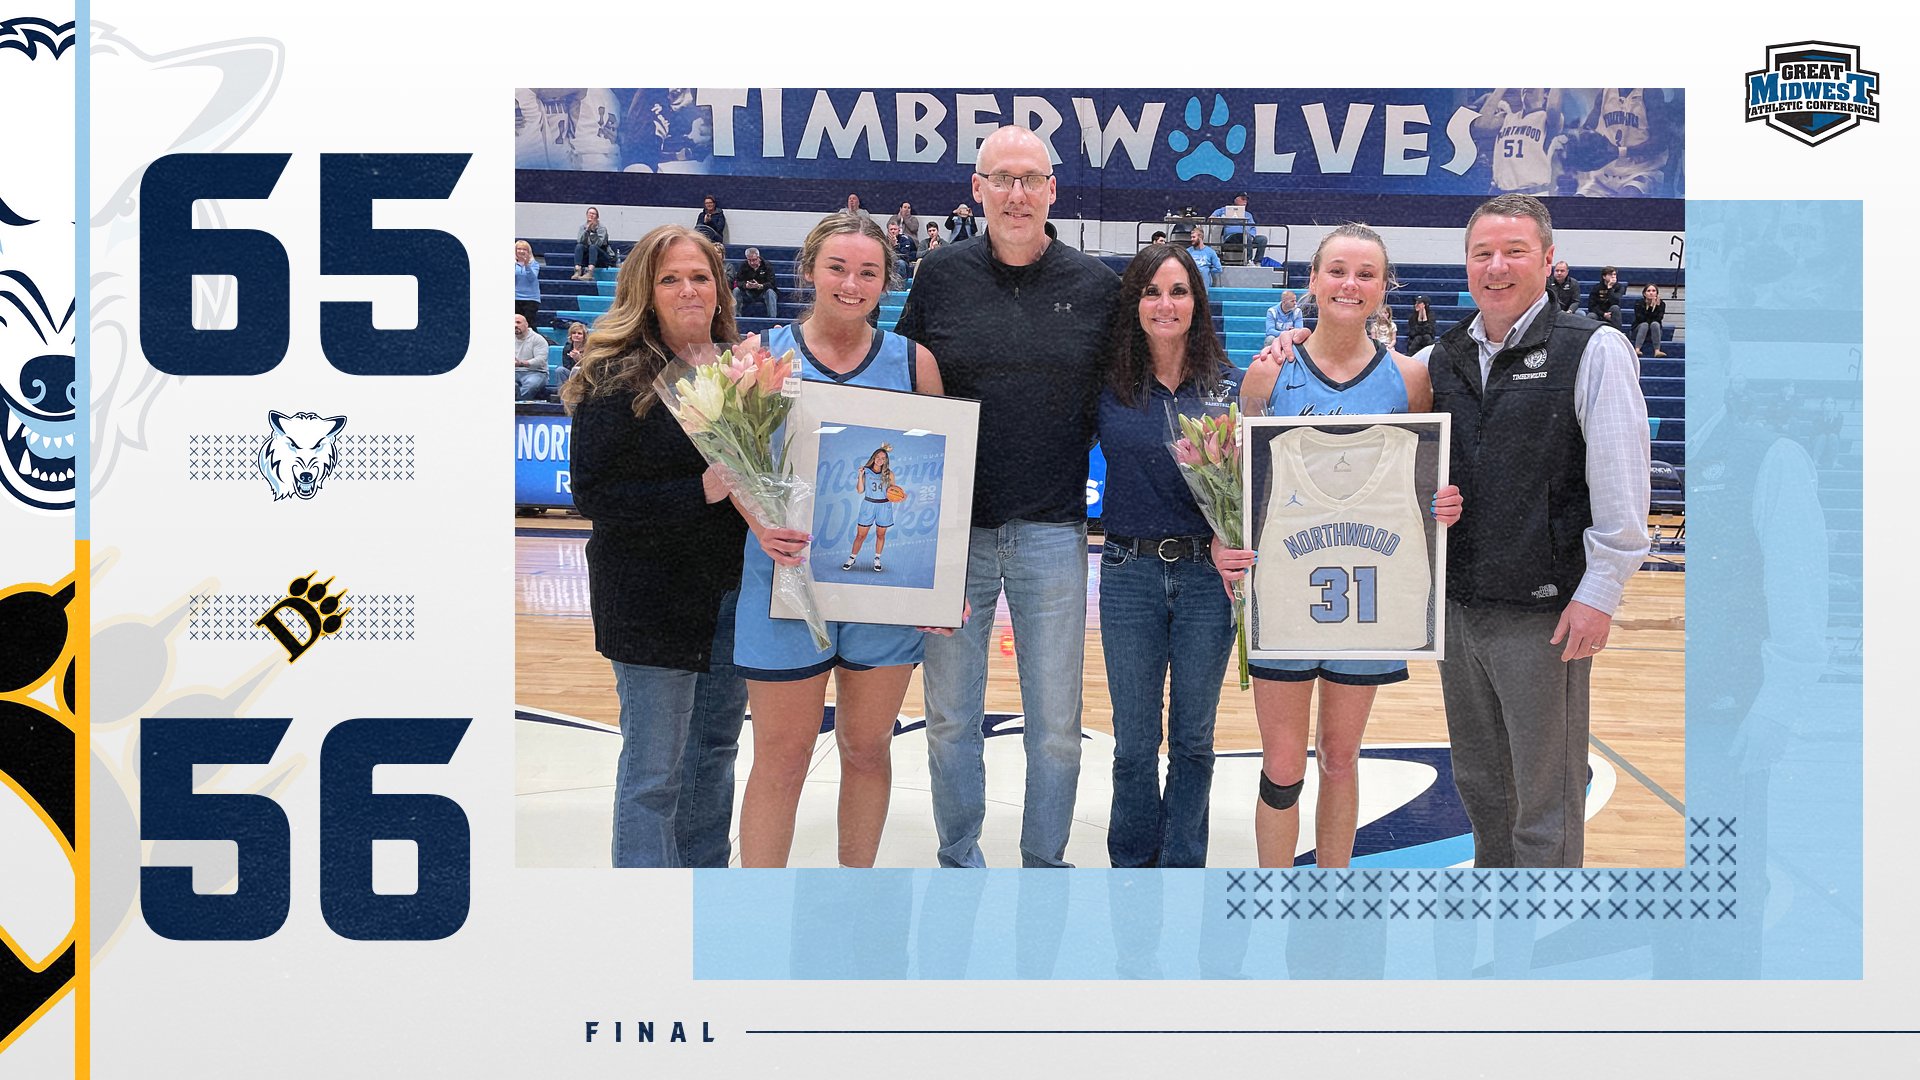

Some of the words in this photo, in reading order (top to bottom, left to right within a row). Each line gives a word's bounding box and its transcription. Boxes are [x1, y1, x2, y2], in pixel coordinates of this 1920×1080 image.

[1503, 139, 1524, 159] 51
[871, 481, 883, 493] 34
[1283, 522, 1401, 559] NORTHWOOD
[1309, 565, 1378, 624] 31
